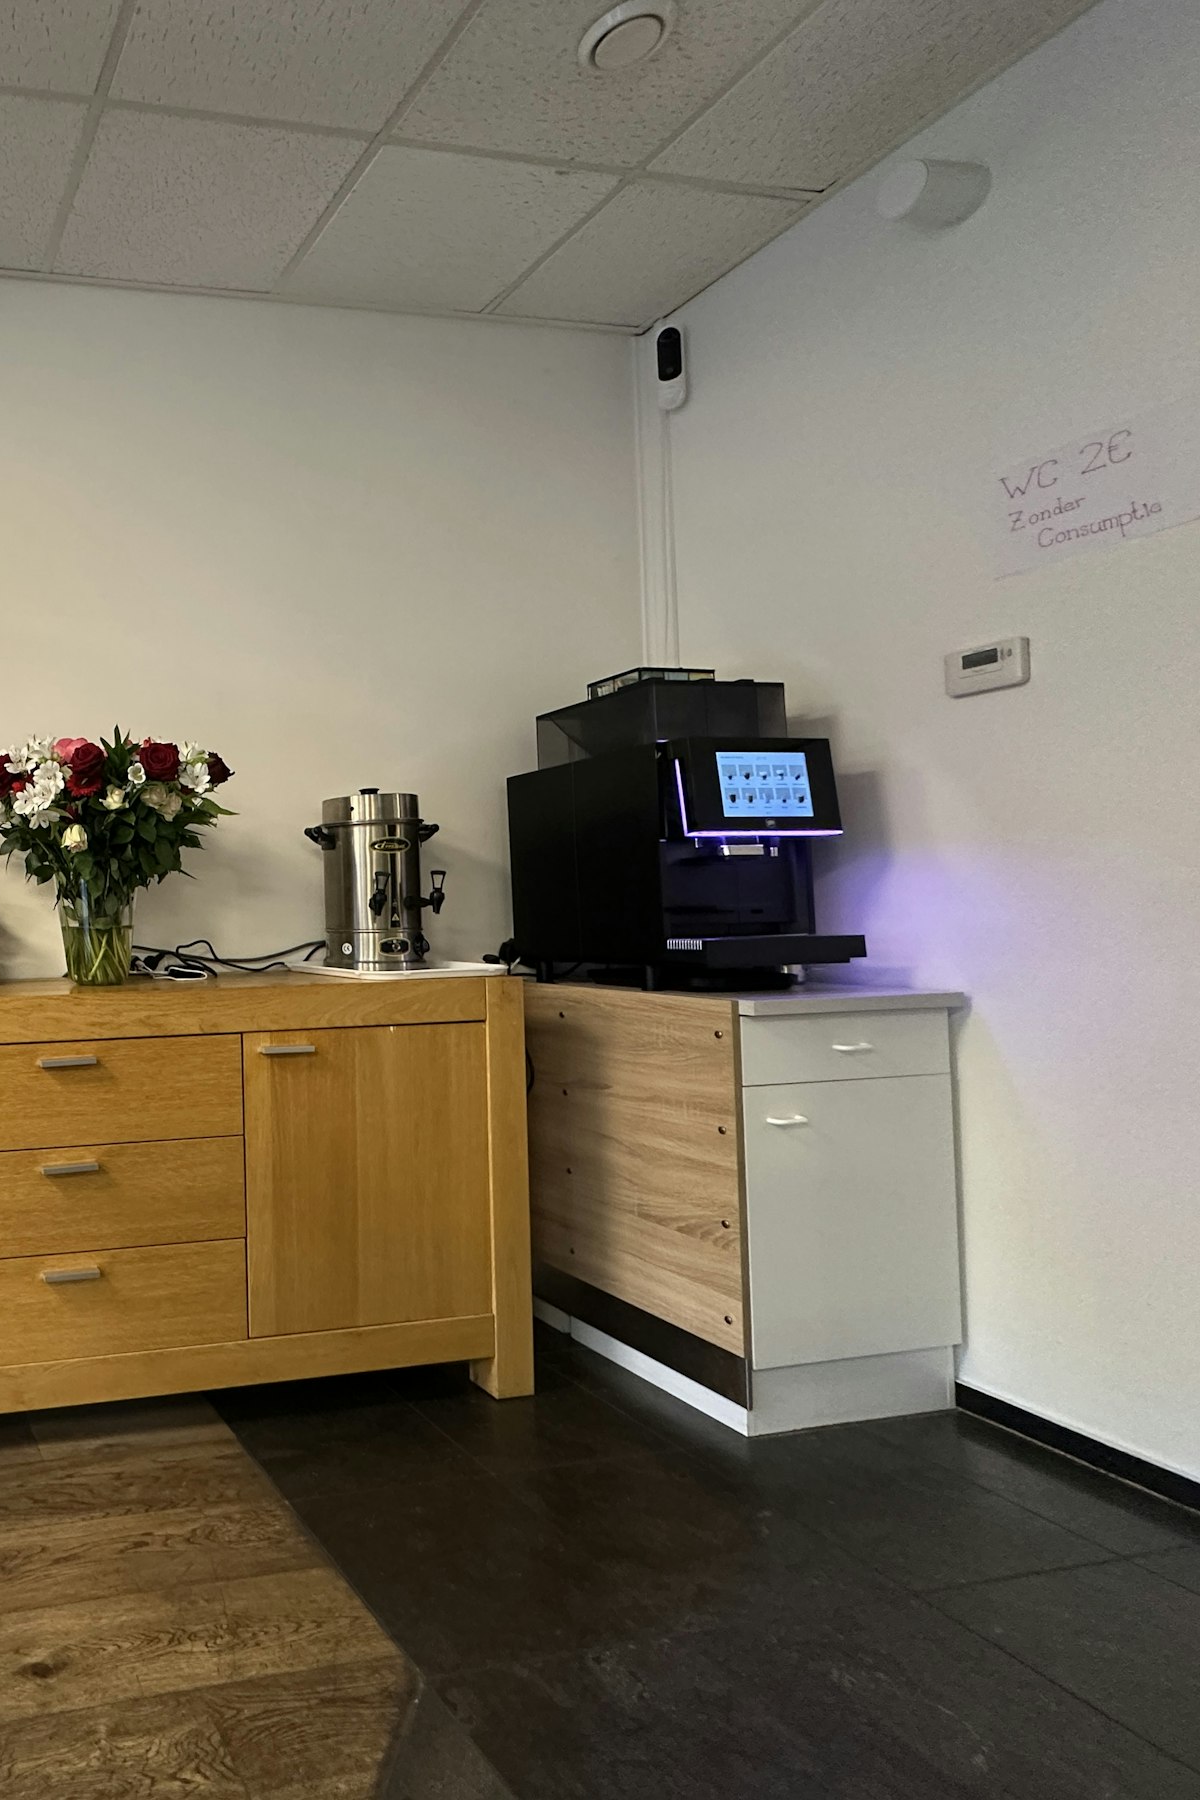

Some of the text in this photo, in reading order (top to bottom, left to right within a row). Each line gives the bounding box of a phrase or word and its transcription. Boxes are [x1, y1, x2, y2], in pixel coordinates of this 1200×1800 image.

[998, 459, 1058, 499] WC
[1008, 496, 1086, 532] Zonder
[1037, 501, 1163, 548] Consumptie
